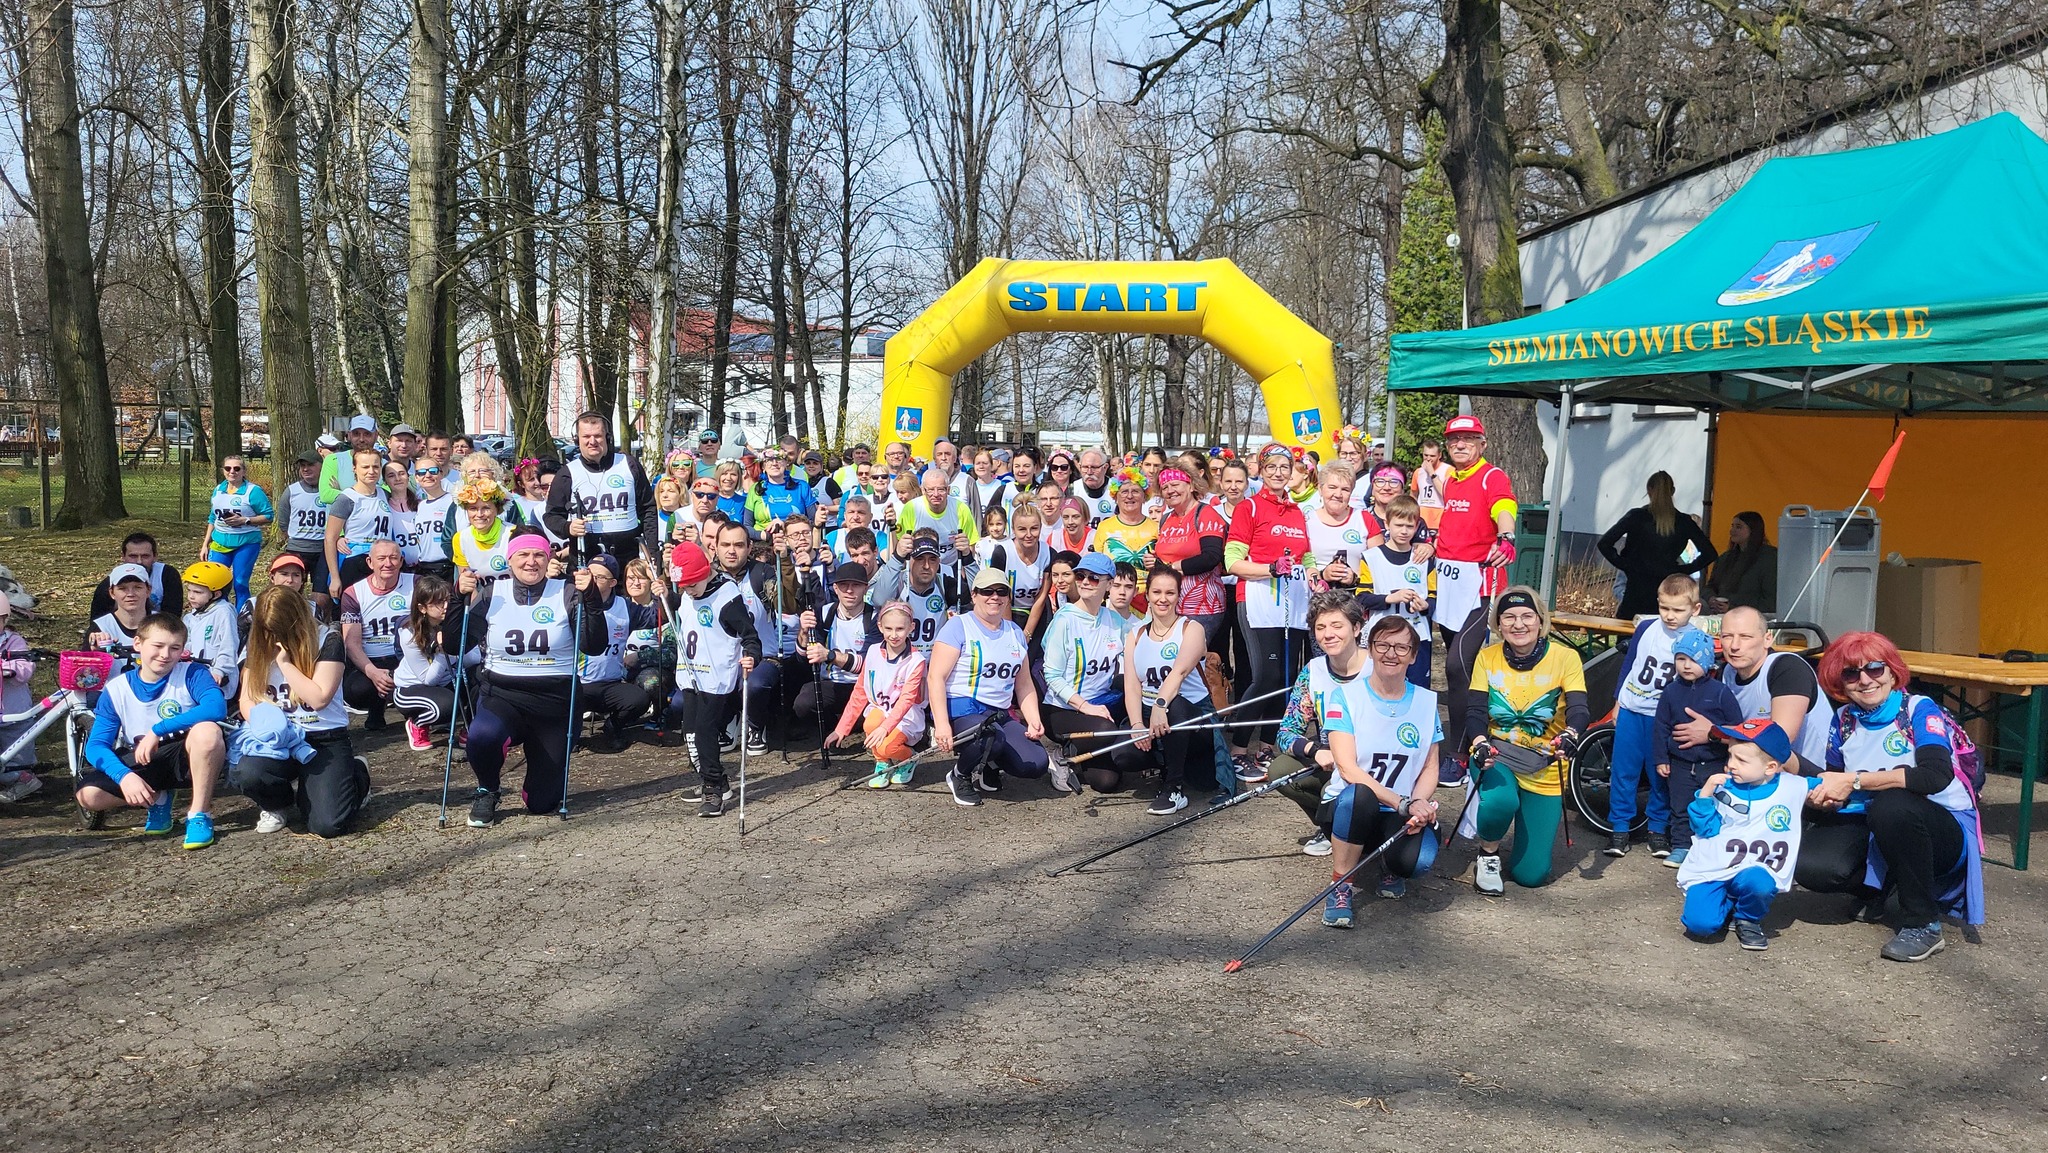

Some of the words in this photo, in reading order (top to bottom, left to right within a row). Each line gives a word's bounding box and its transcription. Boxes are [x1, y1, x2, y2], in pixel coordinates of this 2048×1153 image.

[1008, 281, 1208, 312] START
[1488, 320, 1734, 366] SIEMIANOWICE
[583, 491, 629, 515] 244
[1423, 485, 1433, 498] 15
[298, 510, 327, 527] 238
[374, 515, 389, 537] 14
[415, 520, 445, 536] 378
[1437, 562, 1460, 580] 408
[504, 629, 551, 656] 34
[686, 630, 699, 660] 8
[1638, 655, 1677, 691] 63
[1368, 752, 1410, 789] 57
[1725, 838, 1789, 874] 223
